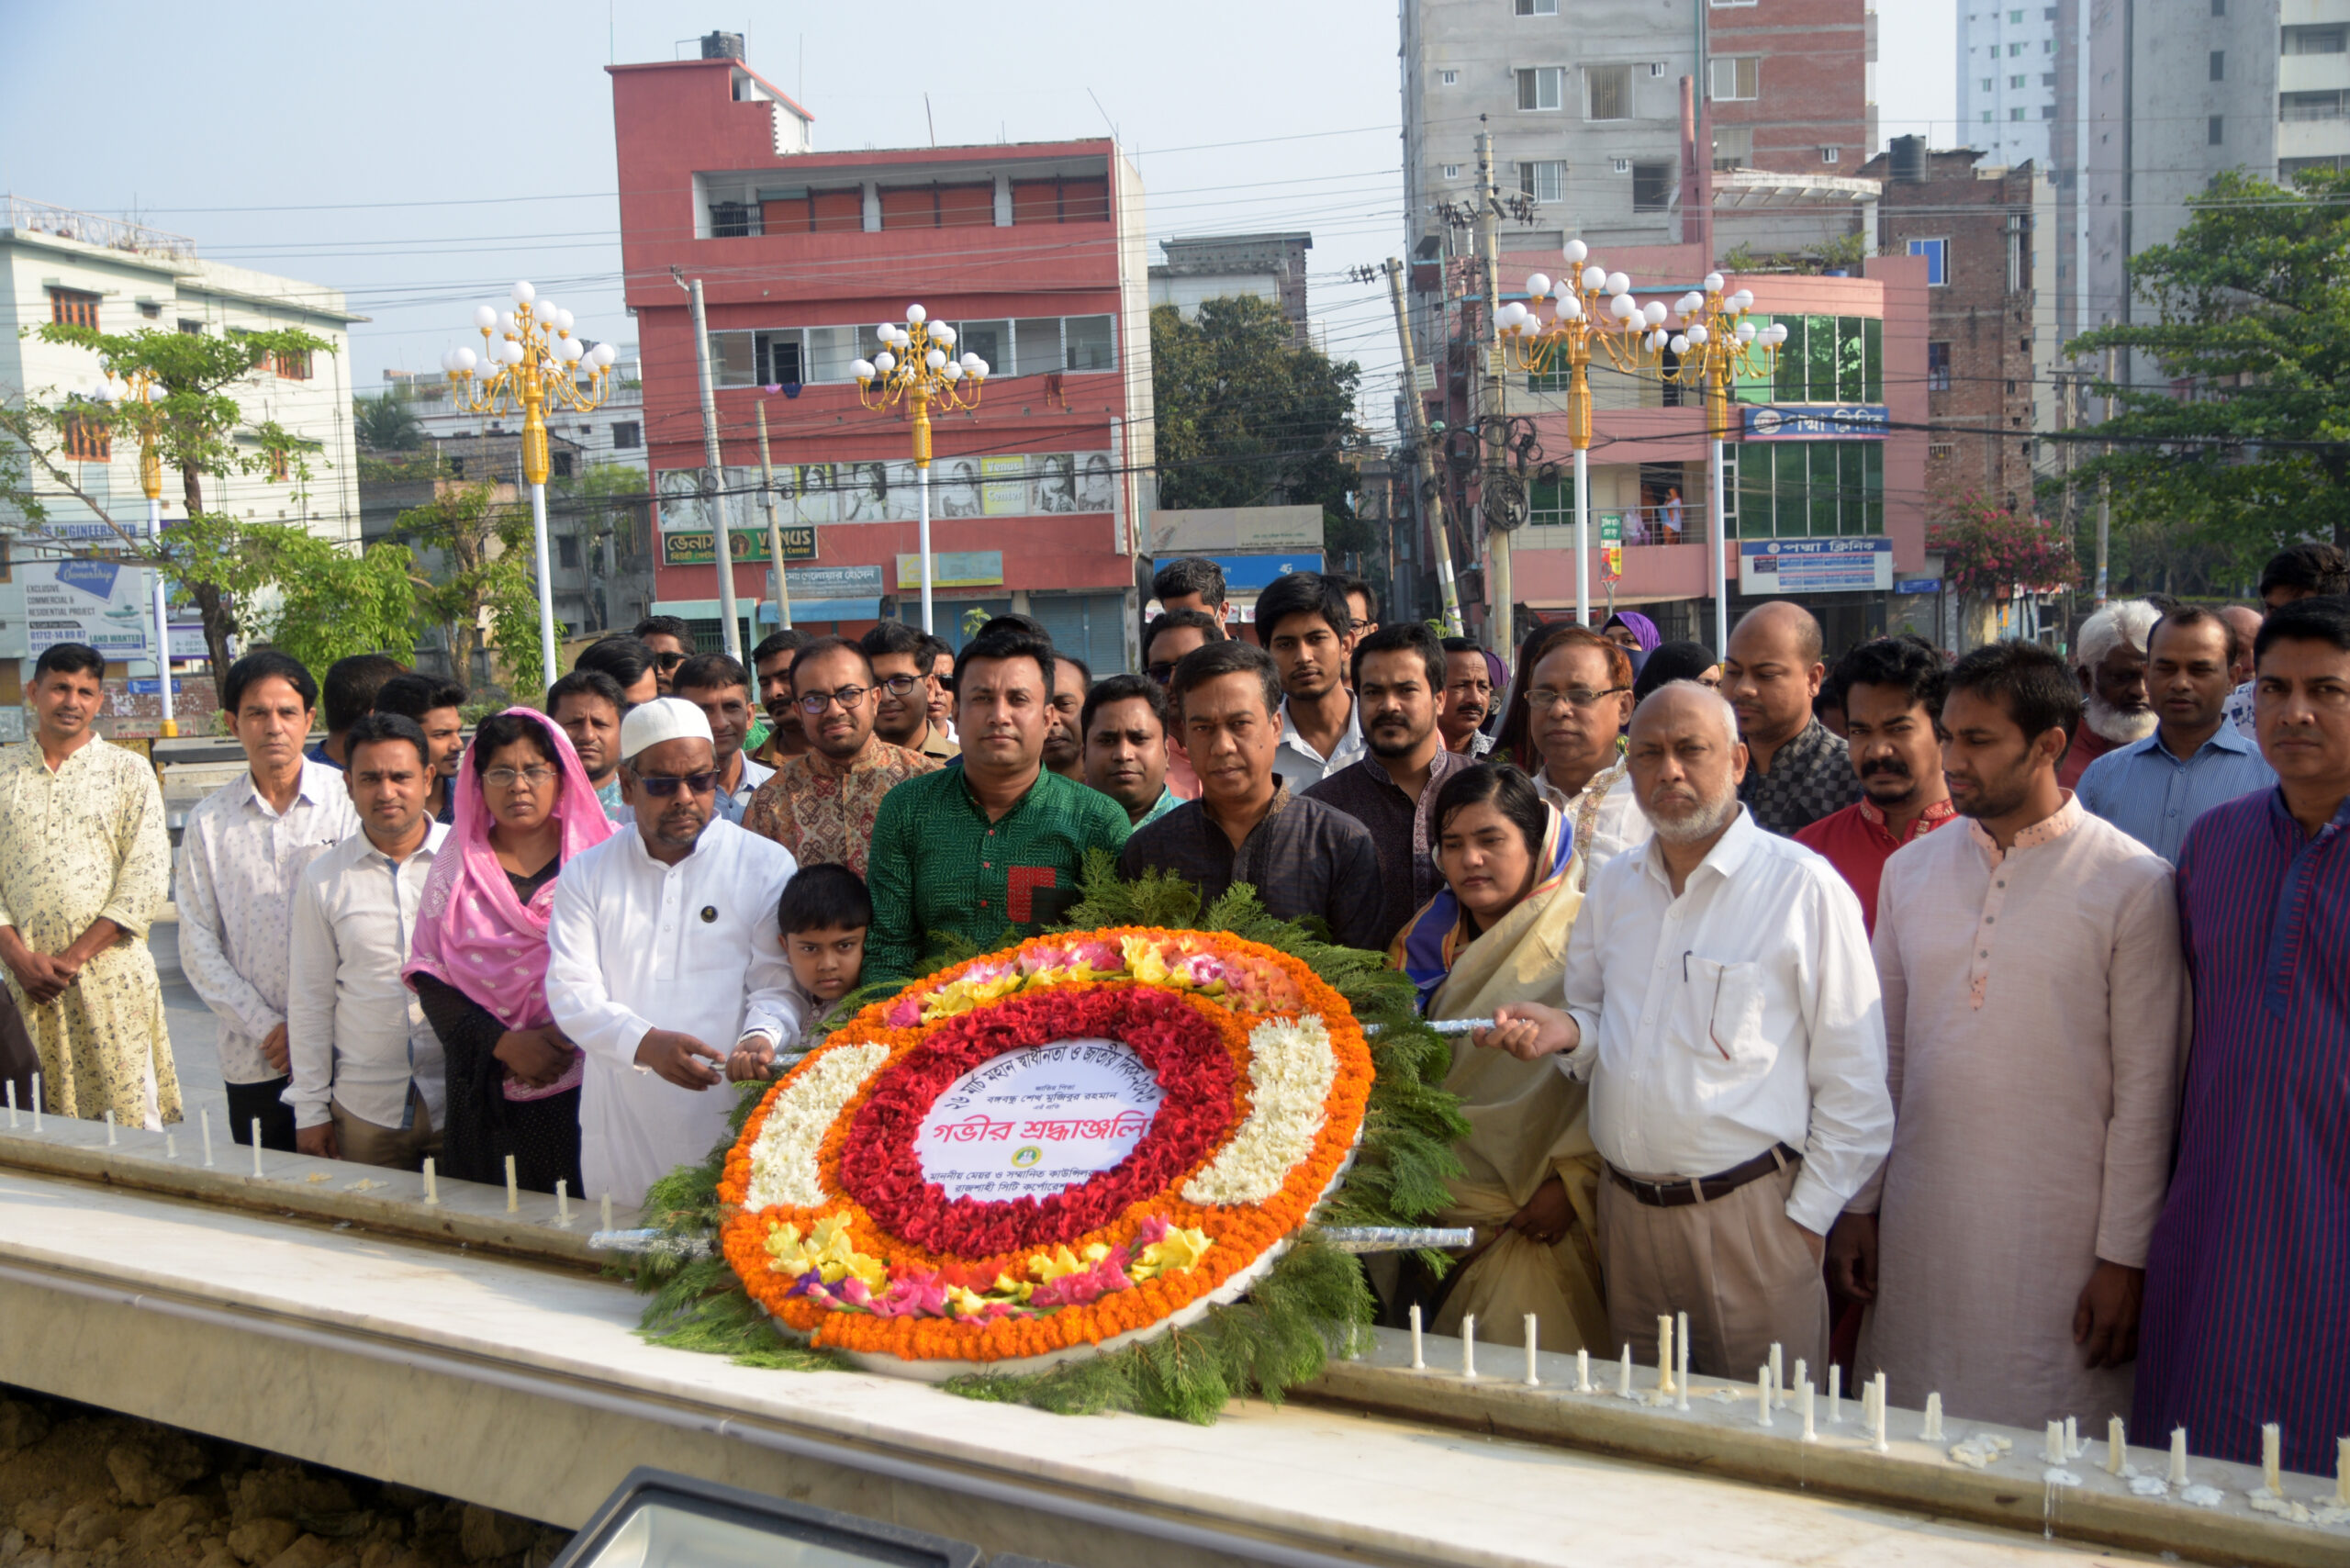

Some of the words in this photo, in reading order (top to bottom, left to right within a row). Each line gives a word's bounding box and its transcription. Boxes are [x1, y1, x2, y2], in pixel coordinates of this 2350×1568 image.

[987, 462, 1021, 472] Venus
[987, 490, 1022, 501] Center
[756, 530, 811, 546] VNUS
[63, 569, 113, 583] Ownership
[27, 585, 59, 593] EXCLUSIVE
[28, 596, 67, 604] COMMERCIAL
[28, 608, 67, 616] RESIDENTIAL
[69, 607, 95, 615] PROJECT
[90, 634, 108, 643] LAND
[110, 633, 140, 643] WANTED
[959, 1072, 986, 1094] মার্চ
[982, 1059, 1016, 1081] মহান
[1015, 1046, 1068, 1069] স্বাধীনতা
[1070, 1047, 1081, 1060] ও
[1083, 1043, 1123, 1067] জাতীয়
[987, 1095, 1018, 1104] বঙ্গবন্ধু
[1021, 1093, 1044, 1103] শেখ
[1046, 1092, 1081, 1103] মুজিবুর
[1084, 1092, 1118, 1100] রহমান
[934, 1114, 1016, 1143] গভীর
[1020, 1110, 1151, 1141] শ্রদ্ধাঞ্জলি
[930, 1170, 964, 1181] মাননীয়
[966, 1170, 990, 1180] মেয়র
[1006, 1168, 1045, 1180] সম্মানিত
[955, 1181, 995, 1193] রাজশাহী
[998, 1181, 1023, 1192] সিটি
